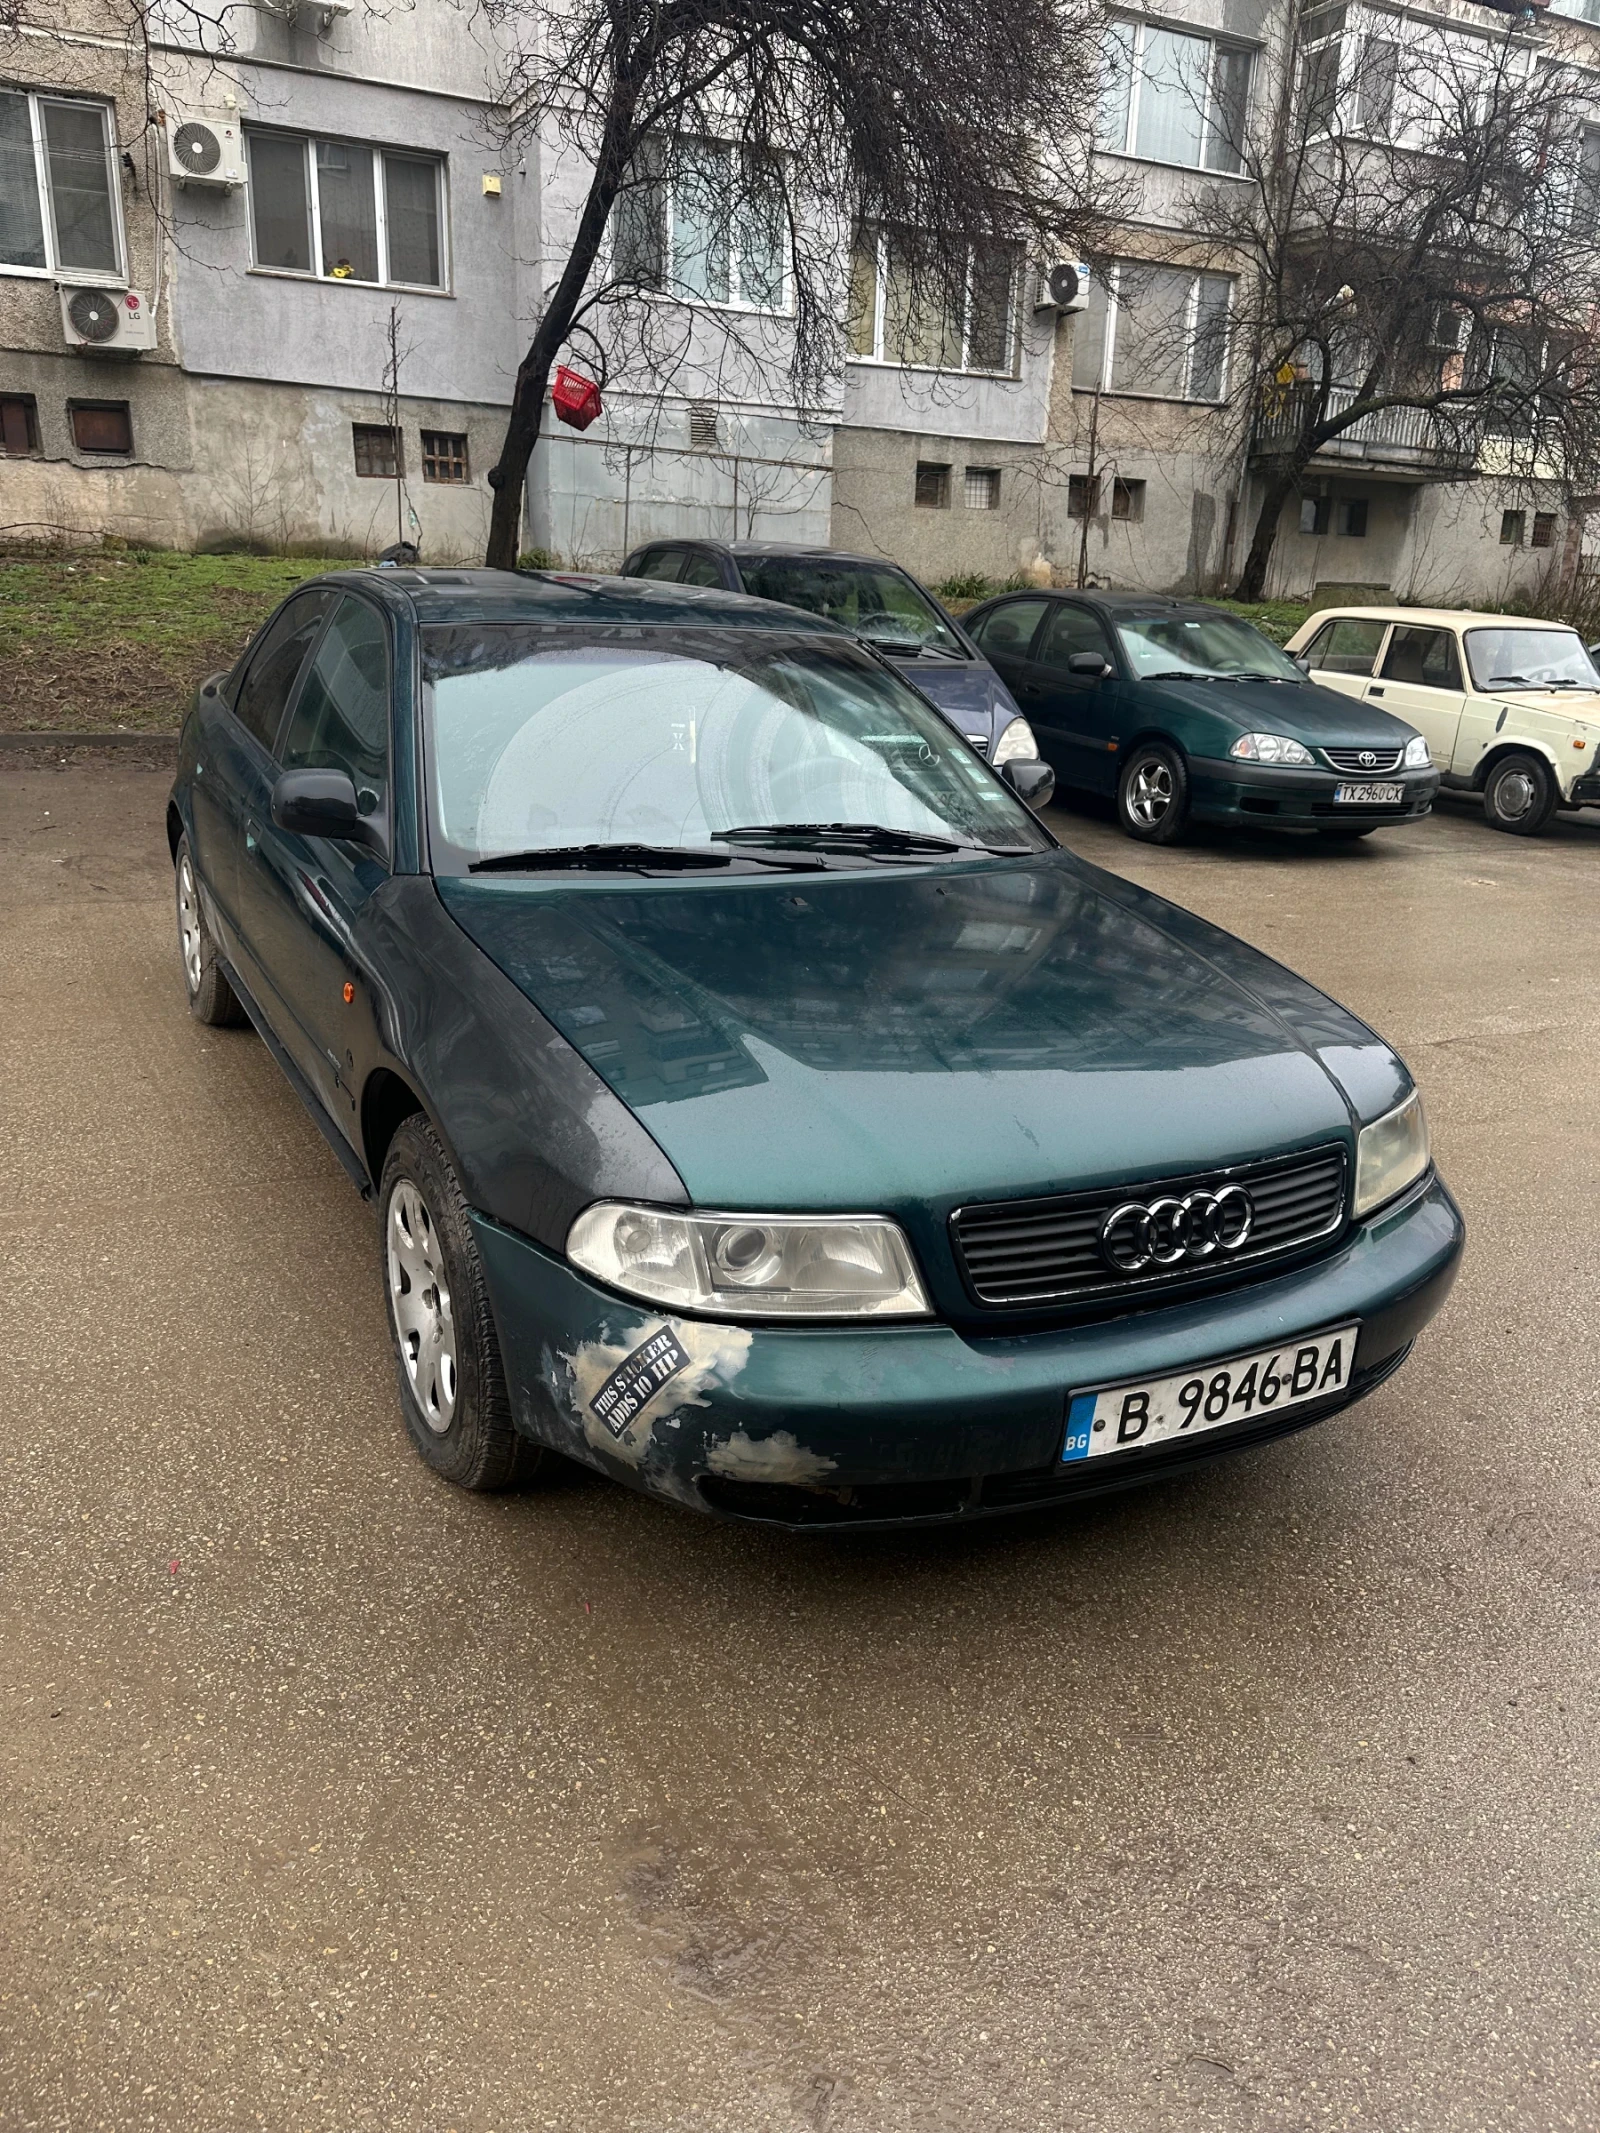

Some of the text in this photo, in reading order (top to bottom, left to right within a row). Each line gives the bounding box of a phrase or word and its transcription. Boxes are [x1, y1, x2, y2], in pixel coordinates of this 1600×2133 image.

[128, 312, 141, 320] LG
[1343, 786, 1402, 801] TX 2960 CX
[594, 1334, 673, 1416] THIS STICKER
[606, 1349, 680, 1433] ADDS 10 HP
[1116, 1338, 1342, 1444] B 9846 BA
[1065, 1433, 1087, 1452] BG
